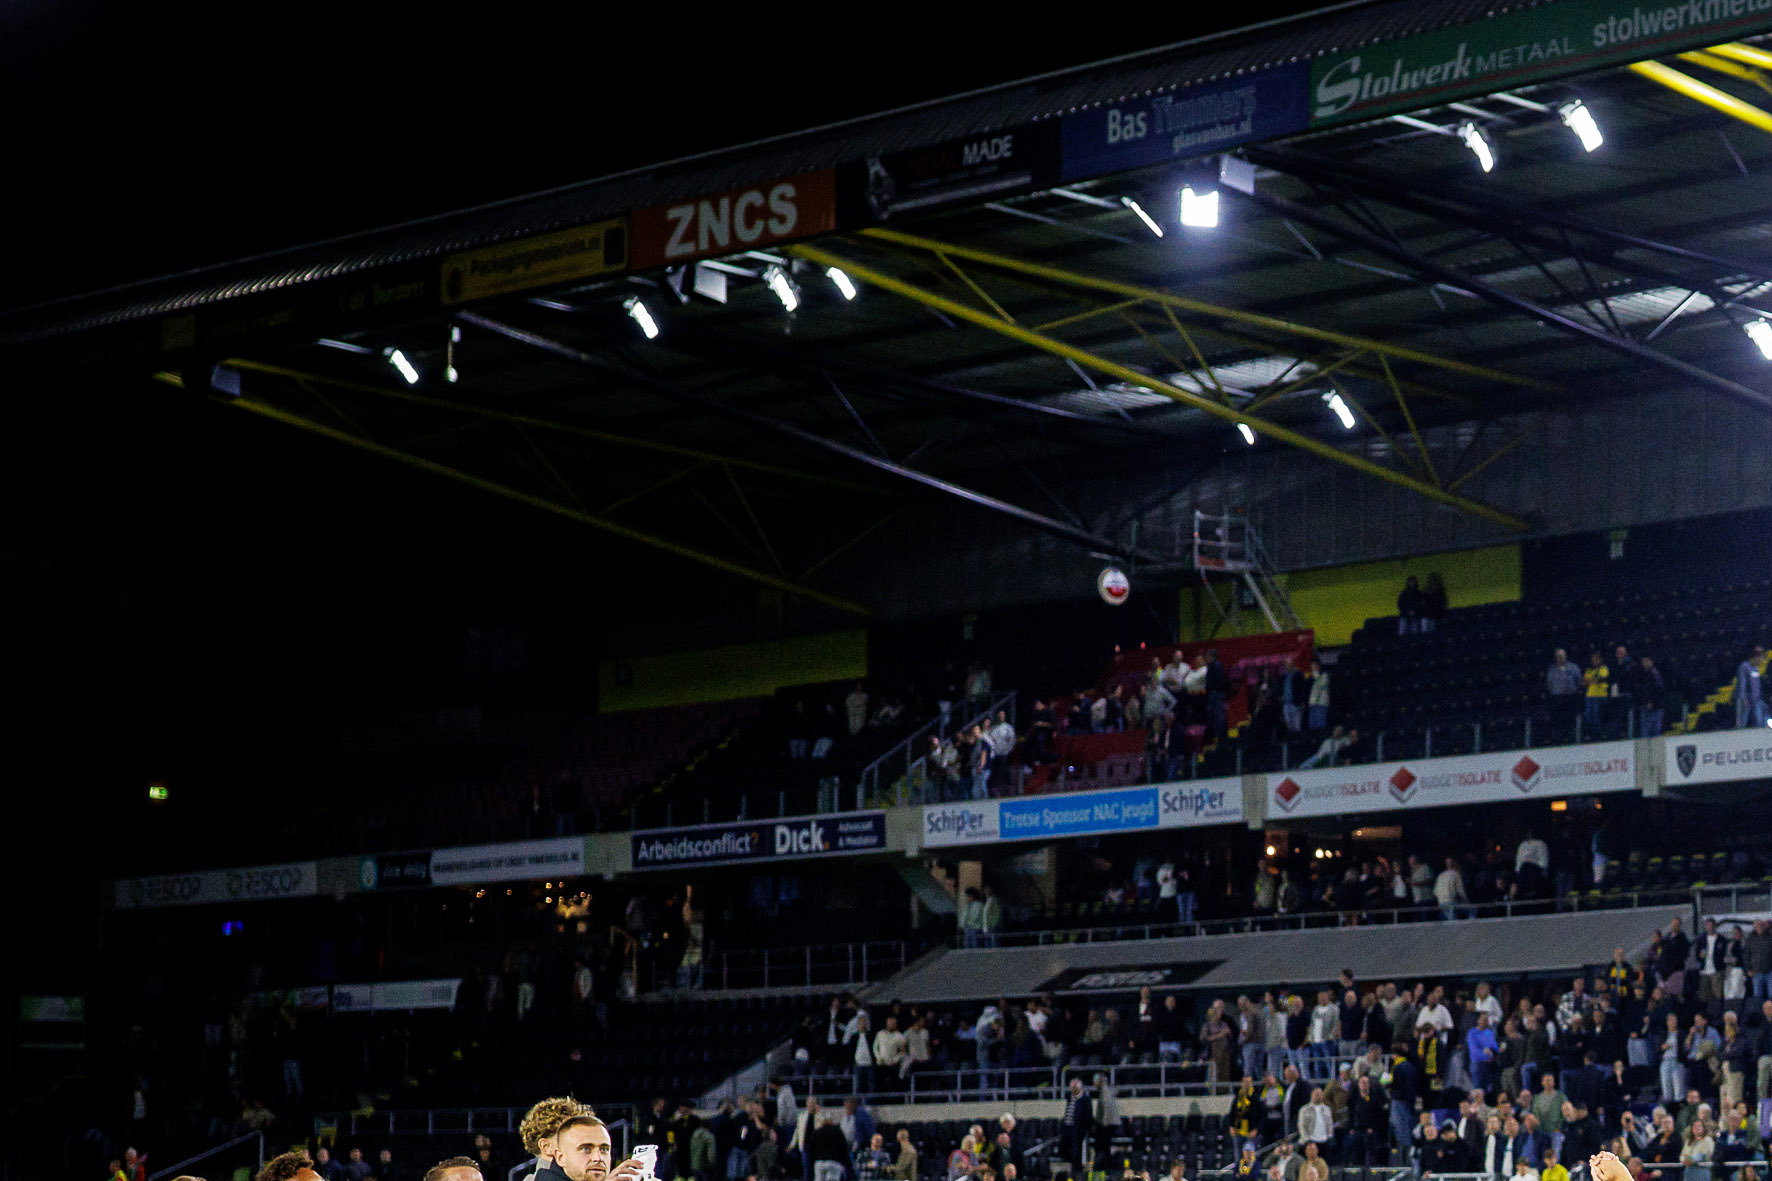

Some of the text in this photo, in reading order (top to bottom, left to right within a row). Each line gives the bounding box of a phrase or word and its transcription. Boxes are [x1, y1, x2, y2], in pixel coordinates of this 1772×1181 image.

[1476, 36, 1576, 72] METAAL
[1107, 107, 1148, 144] Bas
[962, 134, 1014, 167] MADE
[663, 183, 799, 259] ZNCS
[1094, 804, 1119, 822] NAC
[1121, 801, 1155, 824] jeugd
